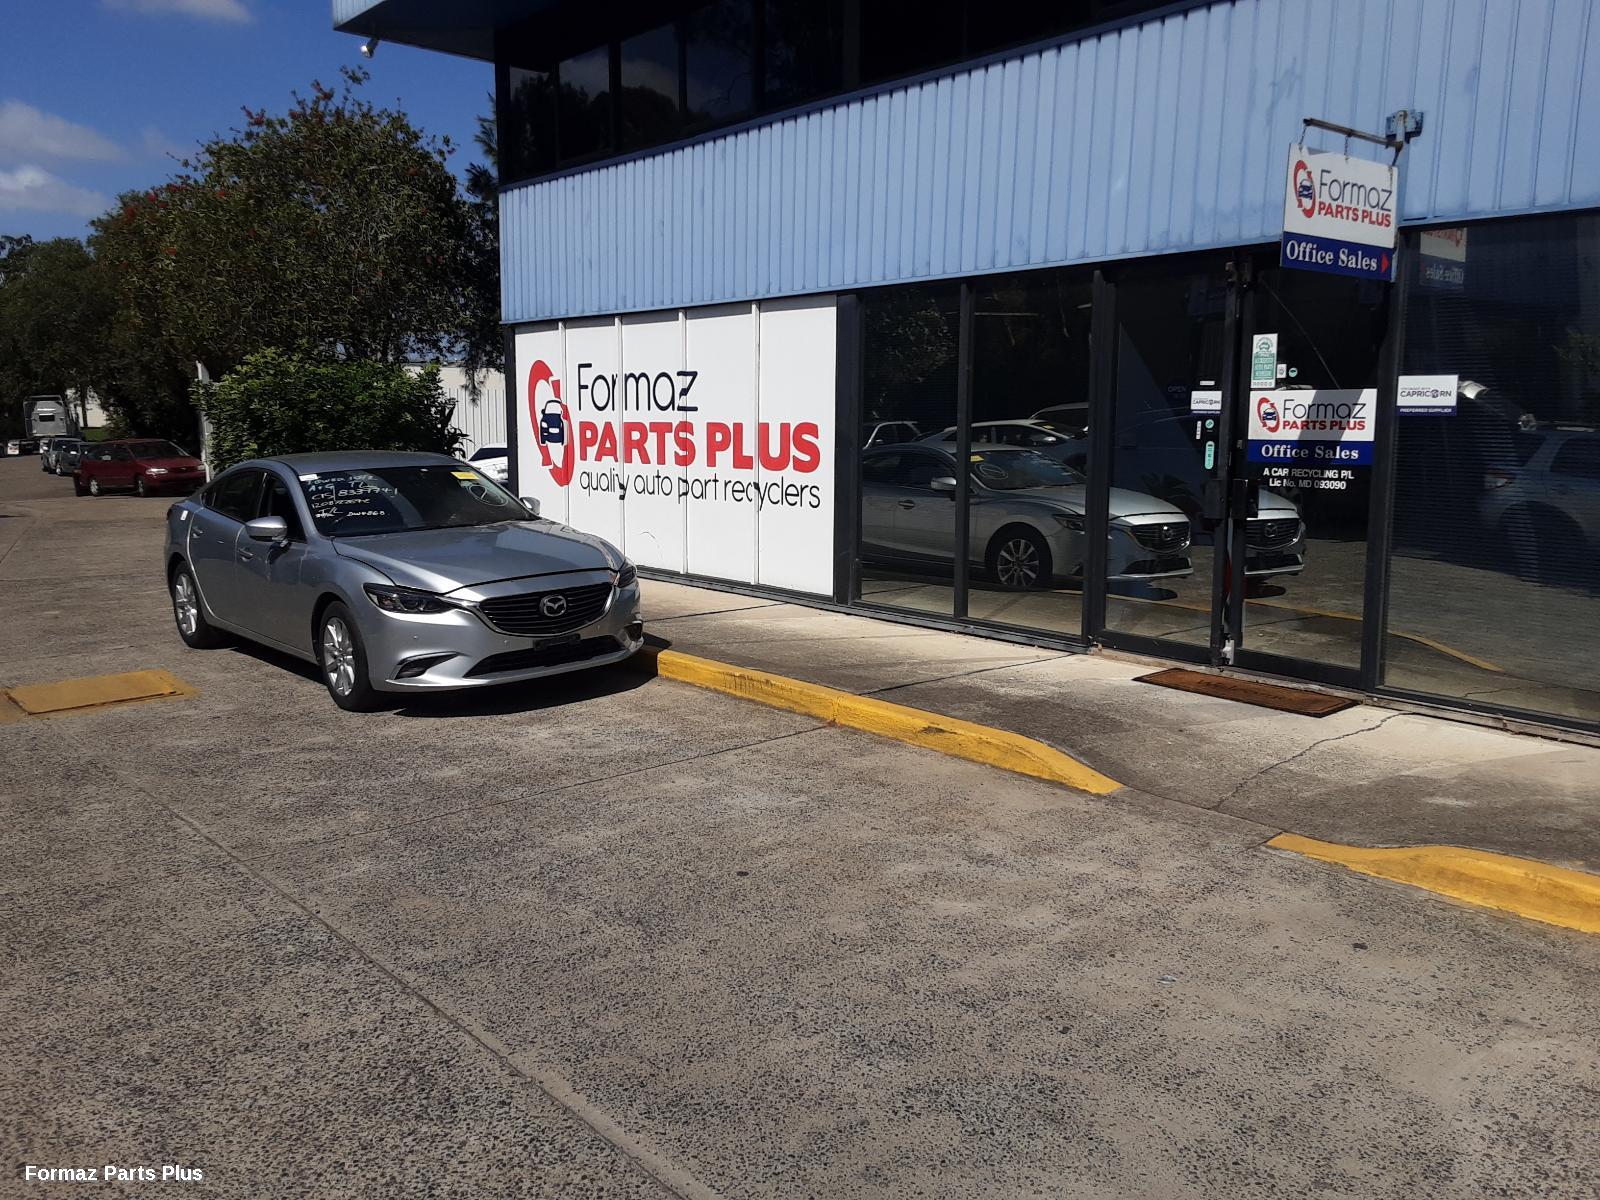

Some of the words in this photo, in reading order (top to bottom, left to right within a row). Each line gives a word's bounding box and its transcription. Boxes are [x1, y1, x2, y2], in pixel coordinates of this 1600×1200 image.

[1319, 169, 1393, 212] Formaz
[1318, 201, 1359, 222] PARTS
[1361, 210, 1392, 228] PLUS
[1286, 240, 1334, 265] Office
[1338, 248, 1378, 271] Sales
[577, 363, 698, 412] Formaz
[1283, 399, 1366, 419] Formaz
[1283, 420, 1327, 430] PARTS
[1330, 420, 1366, 430] PLUS
[579, 420, 696, 467] PARTS
[706, 422, 821, 473] PLUS
[1261, 444, 1309, 458] Office
[1314, 446, 1359, 459] Sales
[1263, 468, 1270, 477] A
[1272, 468, 1289, 478] CAR
[1292, 469, 1338, 479] RECYCLING
[1299, 480, 1311, 489] MD
[1314, 480, 1346, 490] 093090
[580, 467, 629, 501] qualiy
[633, 469, 672, 497] auto
[678, 473, 719, 504] part
[724, 476, 821, 511] recyclers
